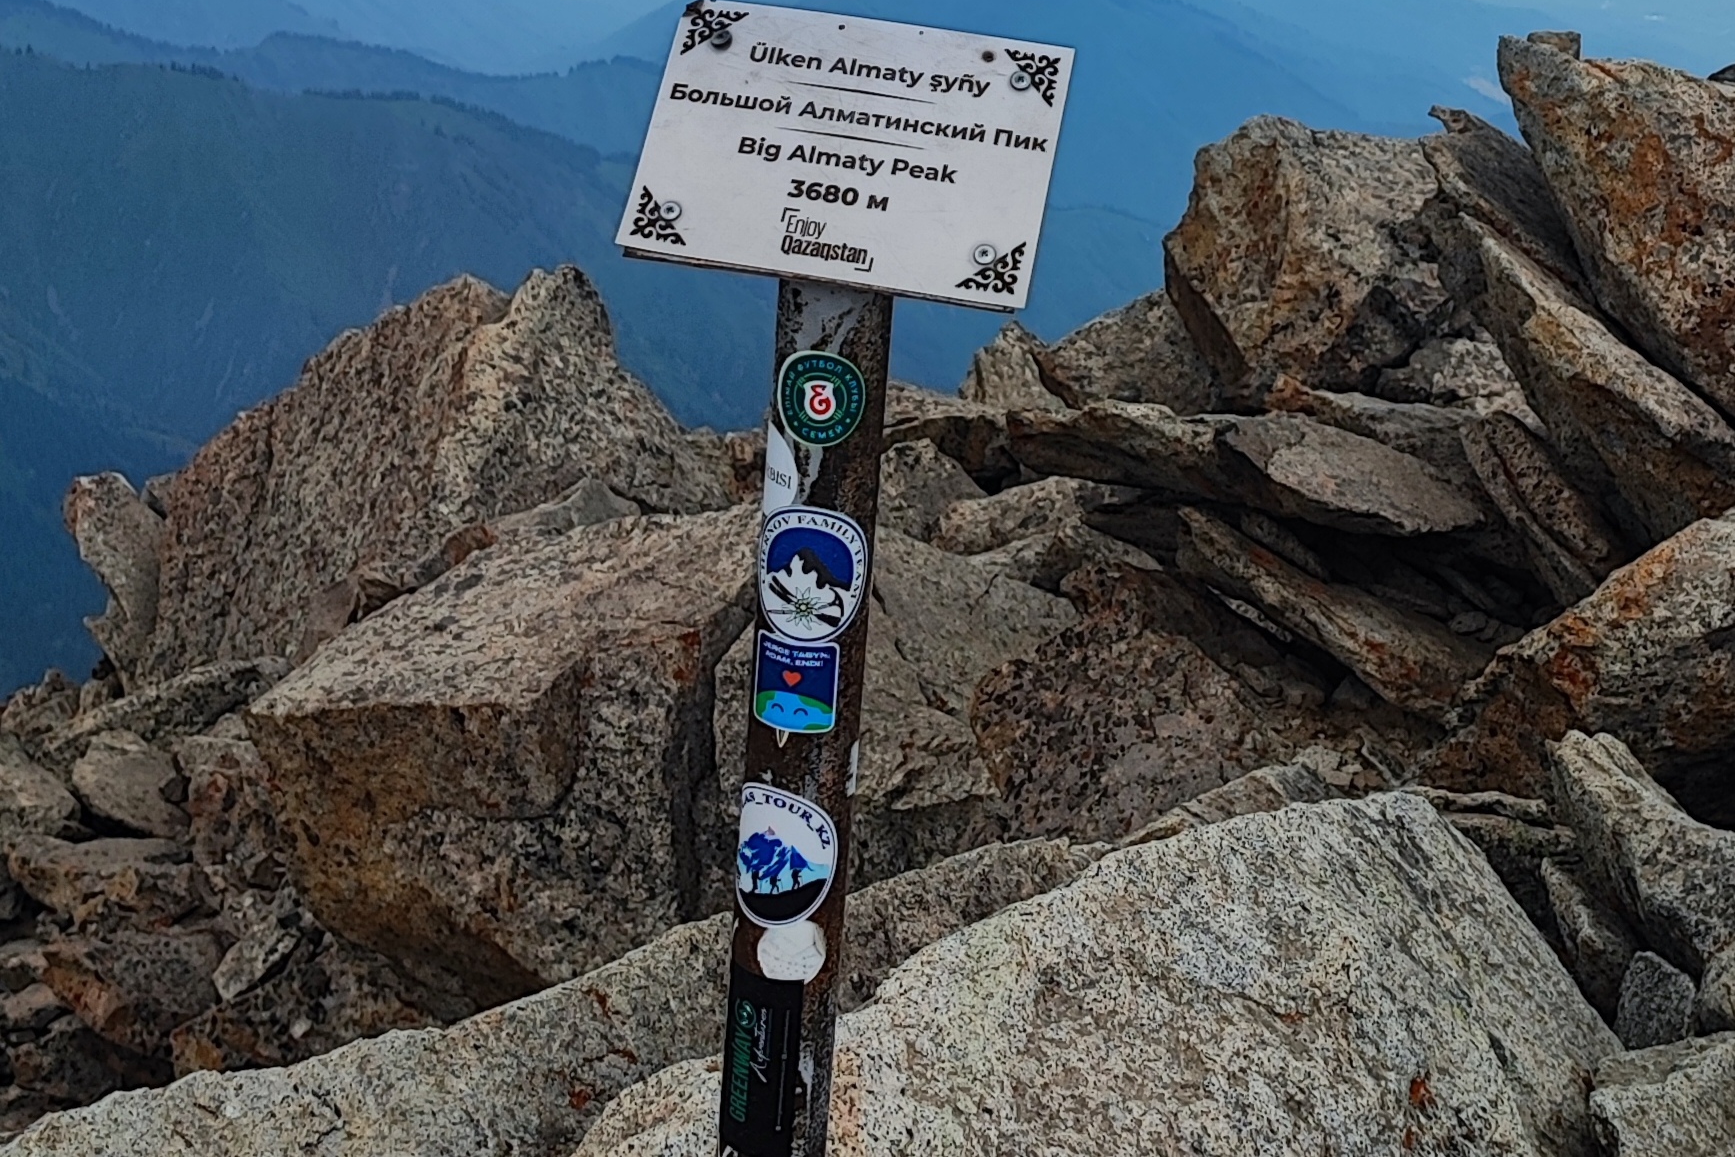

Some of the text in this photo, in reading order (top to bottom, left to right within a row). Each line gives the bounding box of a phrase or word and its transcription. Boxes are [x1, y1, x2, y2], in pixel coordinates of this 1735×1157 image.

[749, 41, 991, 99] Ülken Almaty şyñy
[669, 82, 1049, 153] Большой Алматинский Пик
[737, 136, 958, 184] Big Almaty Peak
[786, 178, 860, 207] 3680
[785, 214, 828, 240] Enjoy
[780, 234, 868, 265] Qazaqstan
[797, 359, 843, 374] ФУТБОЛ
[801, 424, 844, 440] СЕМЕЙ
[797, 515, 859, 544] FAMILY
[850, 545, 863, 599] TEAM
[729, 1023, 753, 1123] GREENWAY
